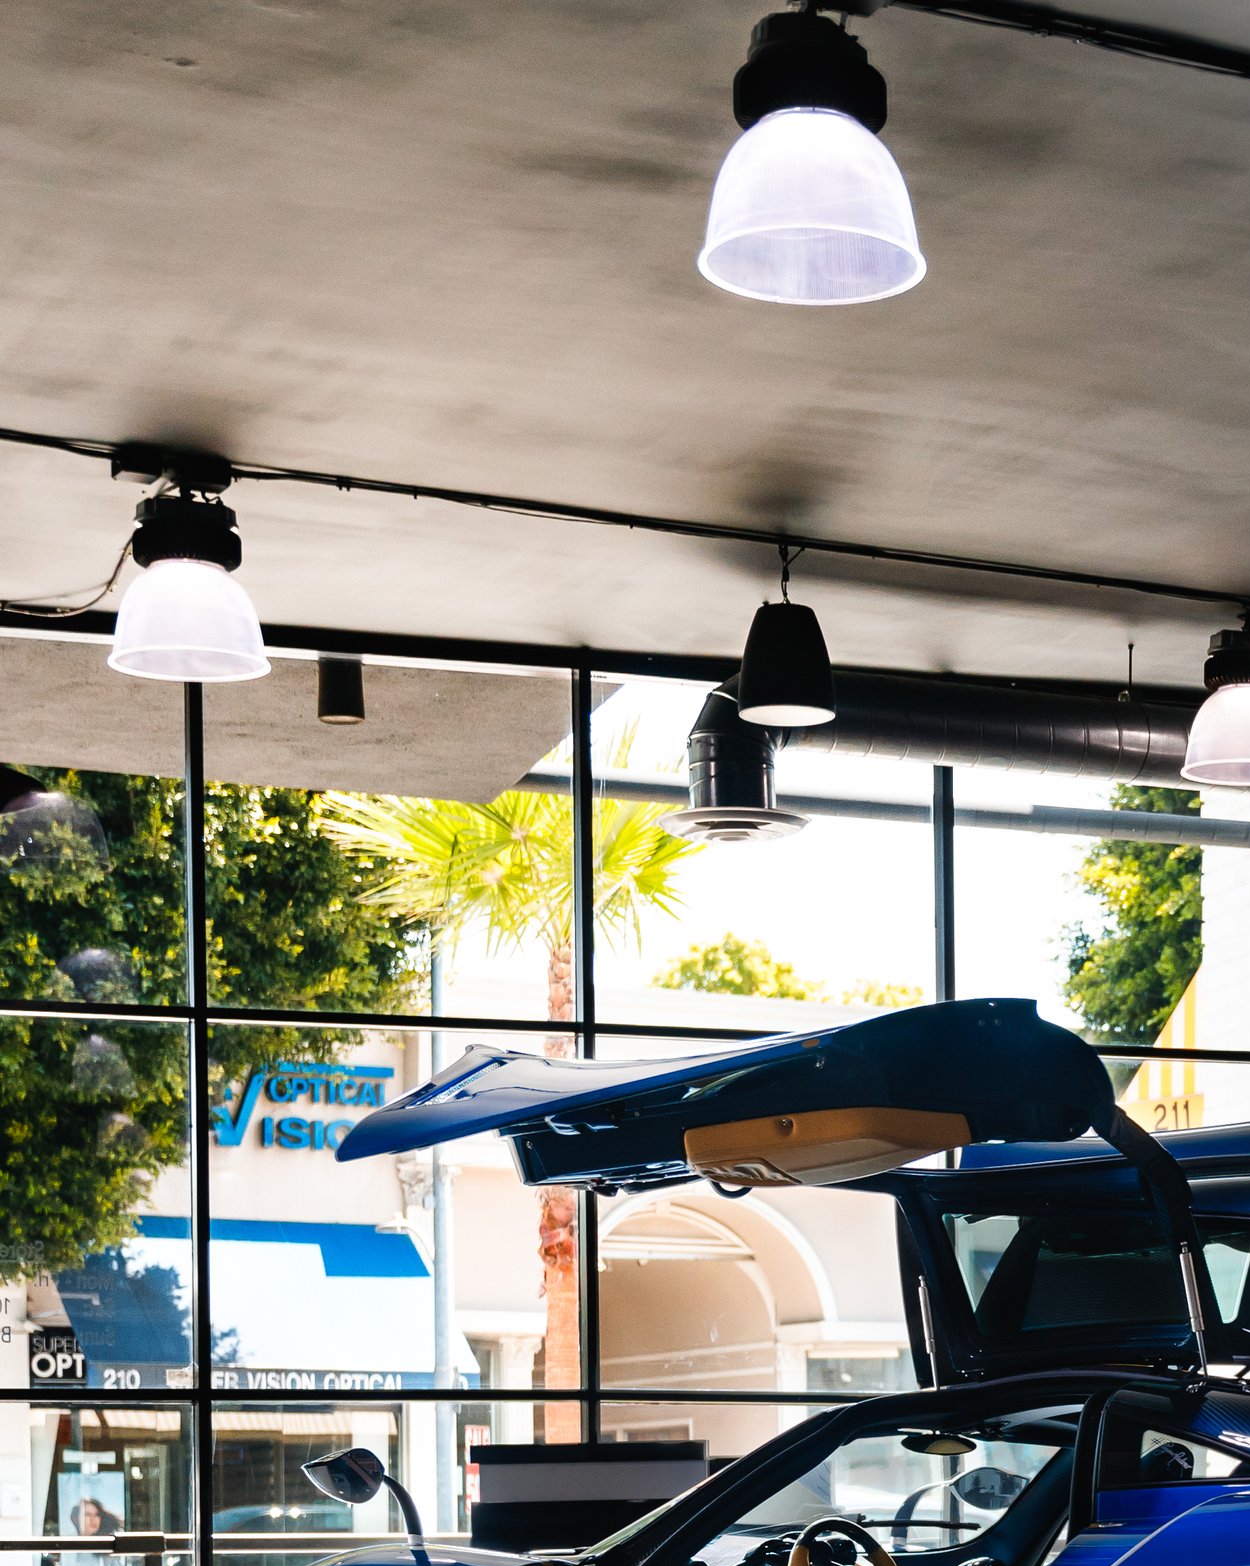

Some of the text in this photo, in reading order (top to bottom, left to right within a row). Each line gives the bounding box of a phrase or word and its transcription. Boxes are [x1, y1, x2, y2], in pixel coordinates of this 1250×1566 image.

[1154, 1100, 1190, 1131] 211
[32, 1353, 85, 1378] OPT
[103, 1369, 140, 1389] 210
[248, 1372, 315, 1389] VISION
